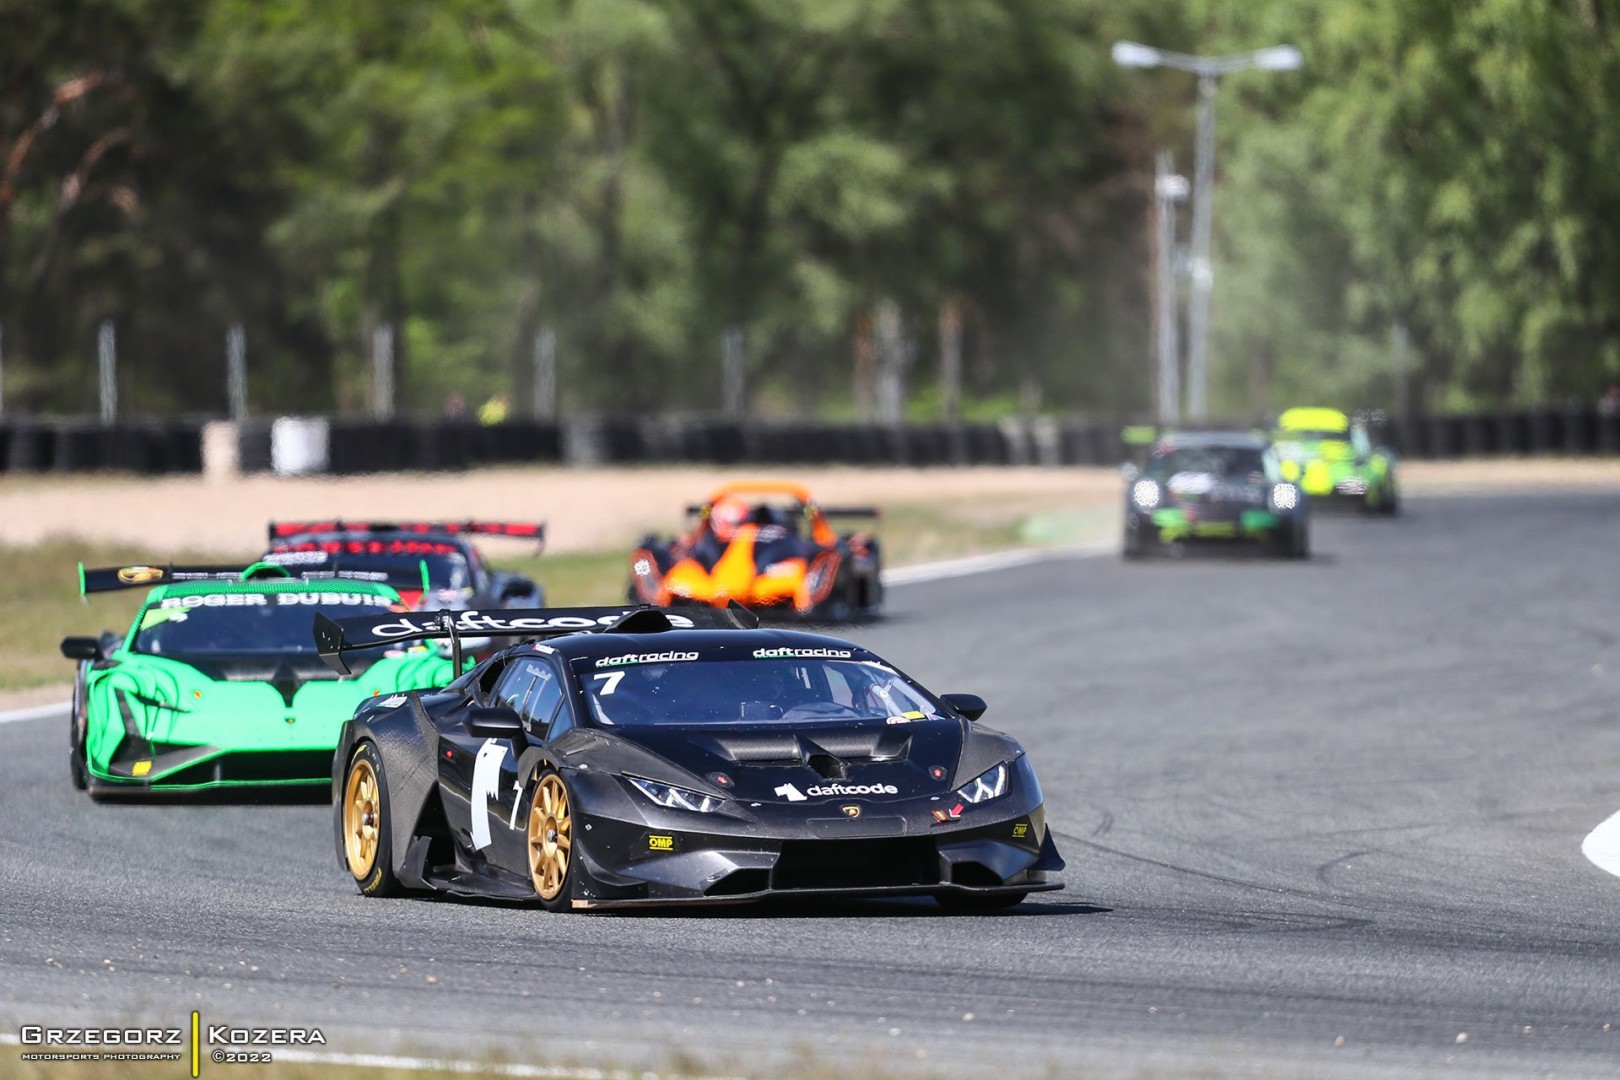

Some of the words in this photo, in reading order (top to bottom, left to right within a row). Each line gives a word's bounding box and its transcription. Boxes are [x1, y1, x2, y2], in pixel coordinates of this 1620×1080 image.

[161, 594, 267, 609] ROGER
[277, 592, 392, 606] DUBUIS
[595, 651, 699, 667] daftracing
[753, 647, 851, 658] daftracing
[594, 671, 625, 695] 7
[807, 783, 898, 796] daftcode
[649, 838, 673, 847] OMP
